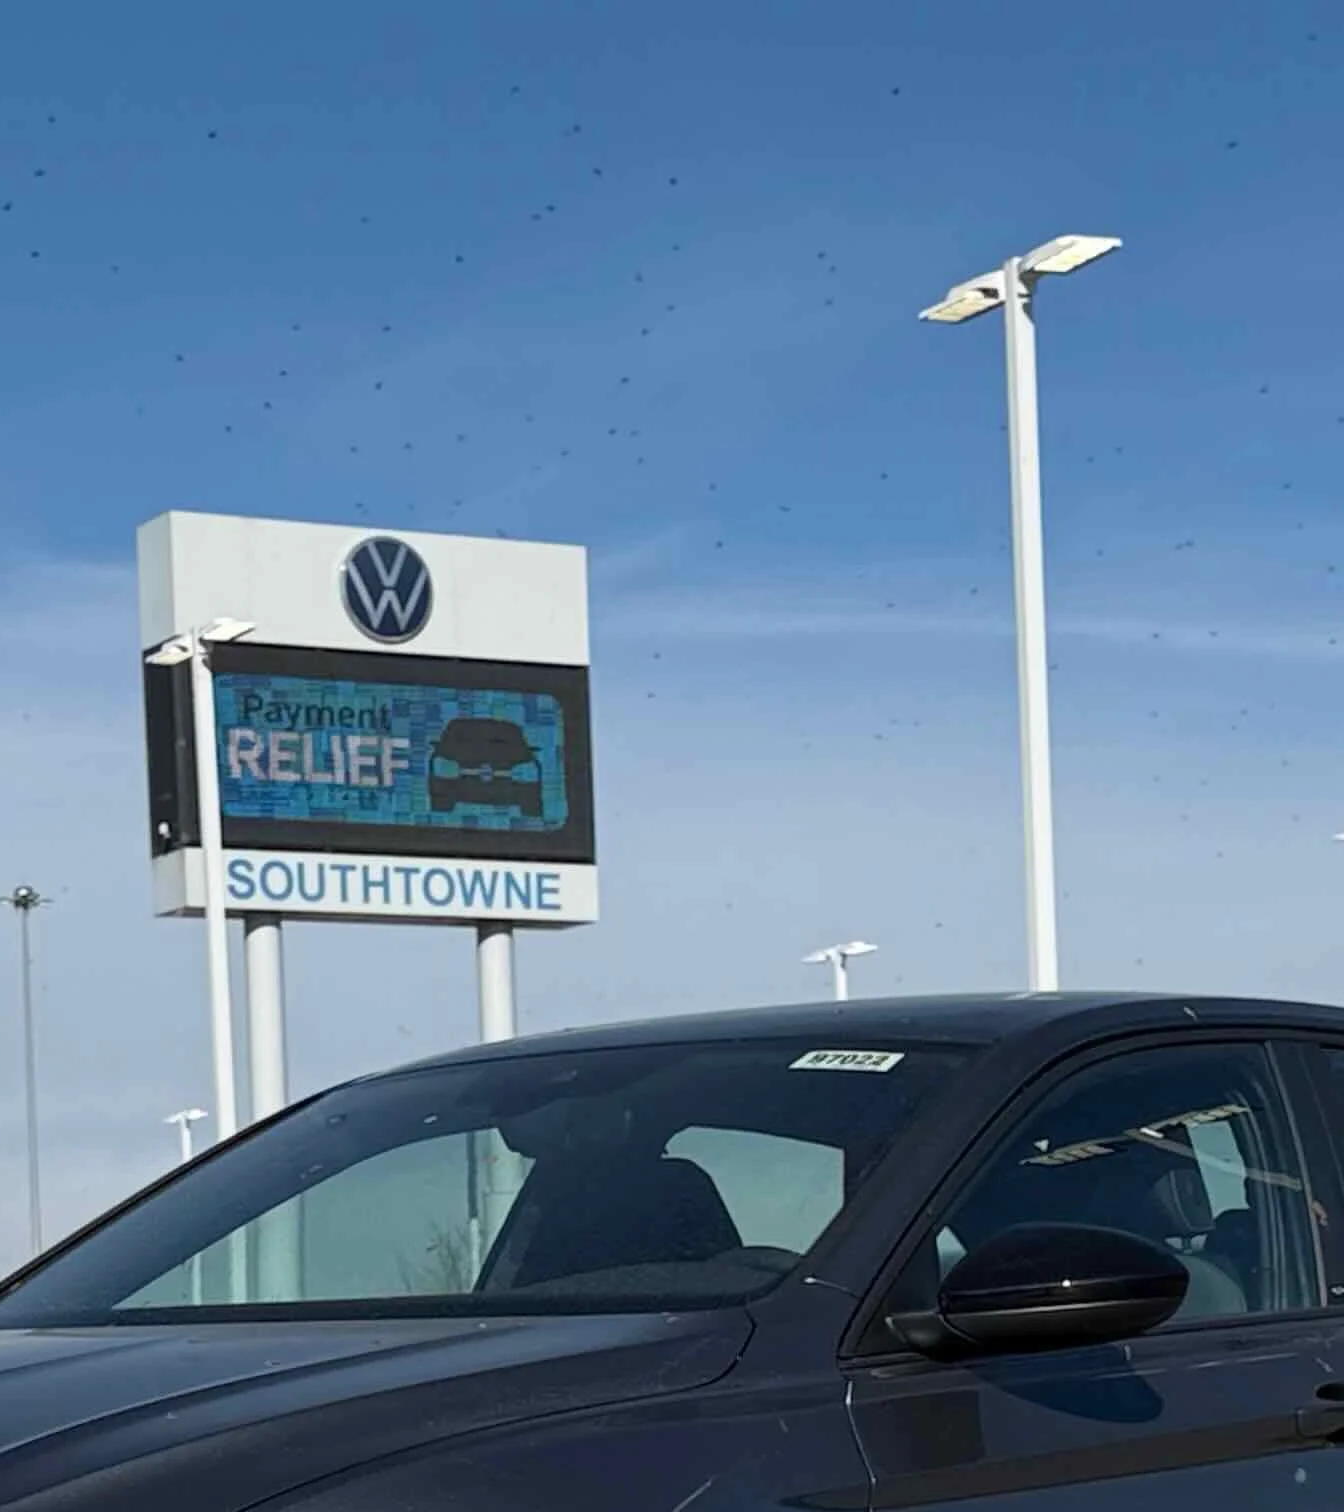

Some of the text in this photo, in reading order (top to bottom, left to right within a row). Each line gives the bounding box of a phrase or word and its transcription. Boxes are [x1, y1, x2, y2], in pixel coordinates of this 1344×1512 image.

[243, 693, 392, 732] Payment
[228, 728, 409, 786] RELIEF
[228, 859, 561, 910] SOUTHTOWNE
